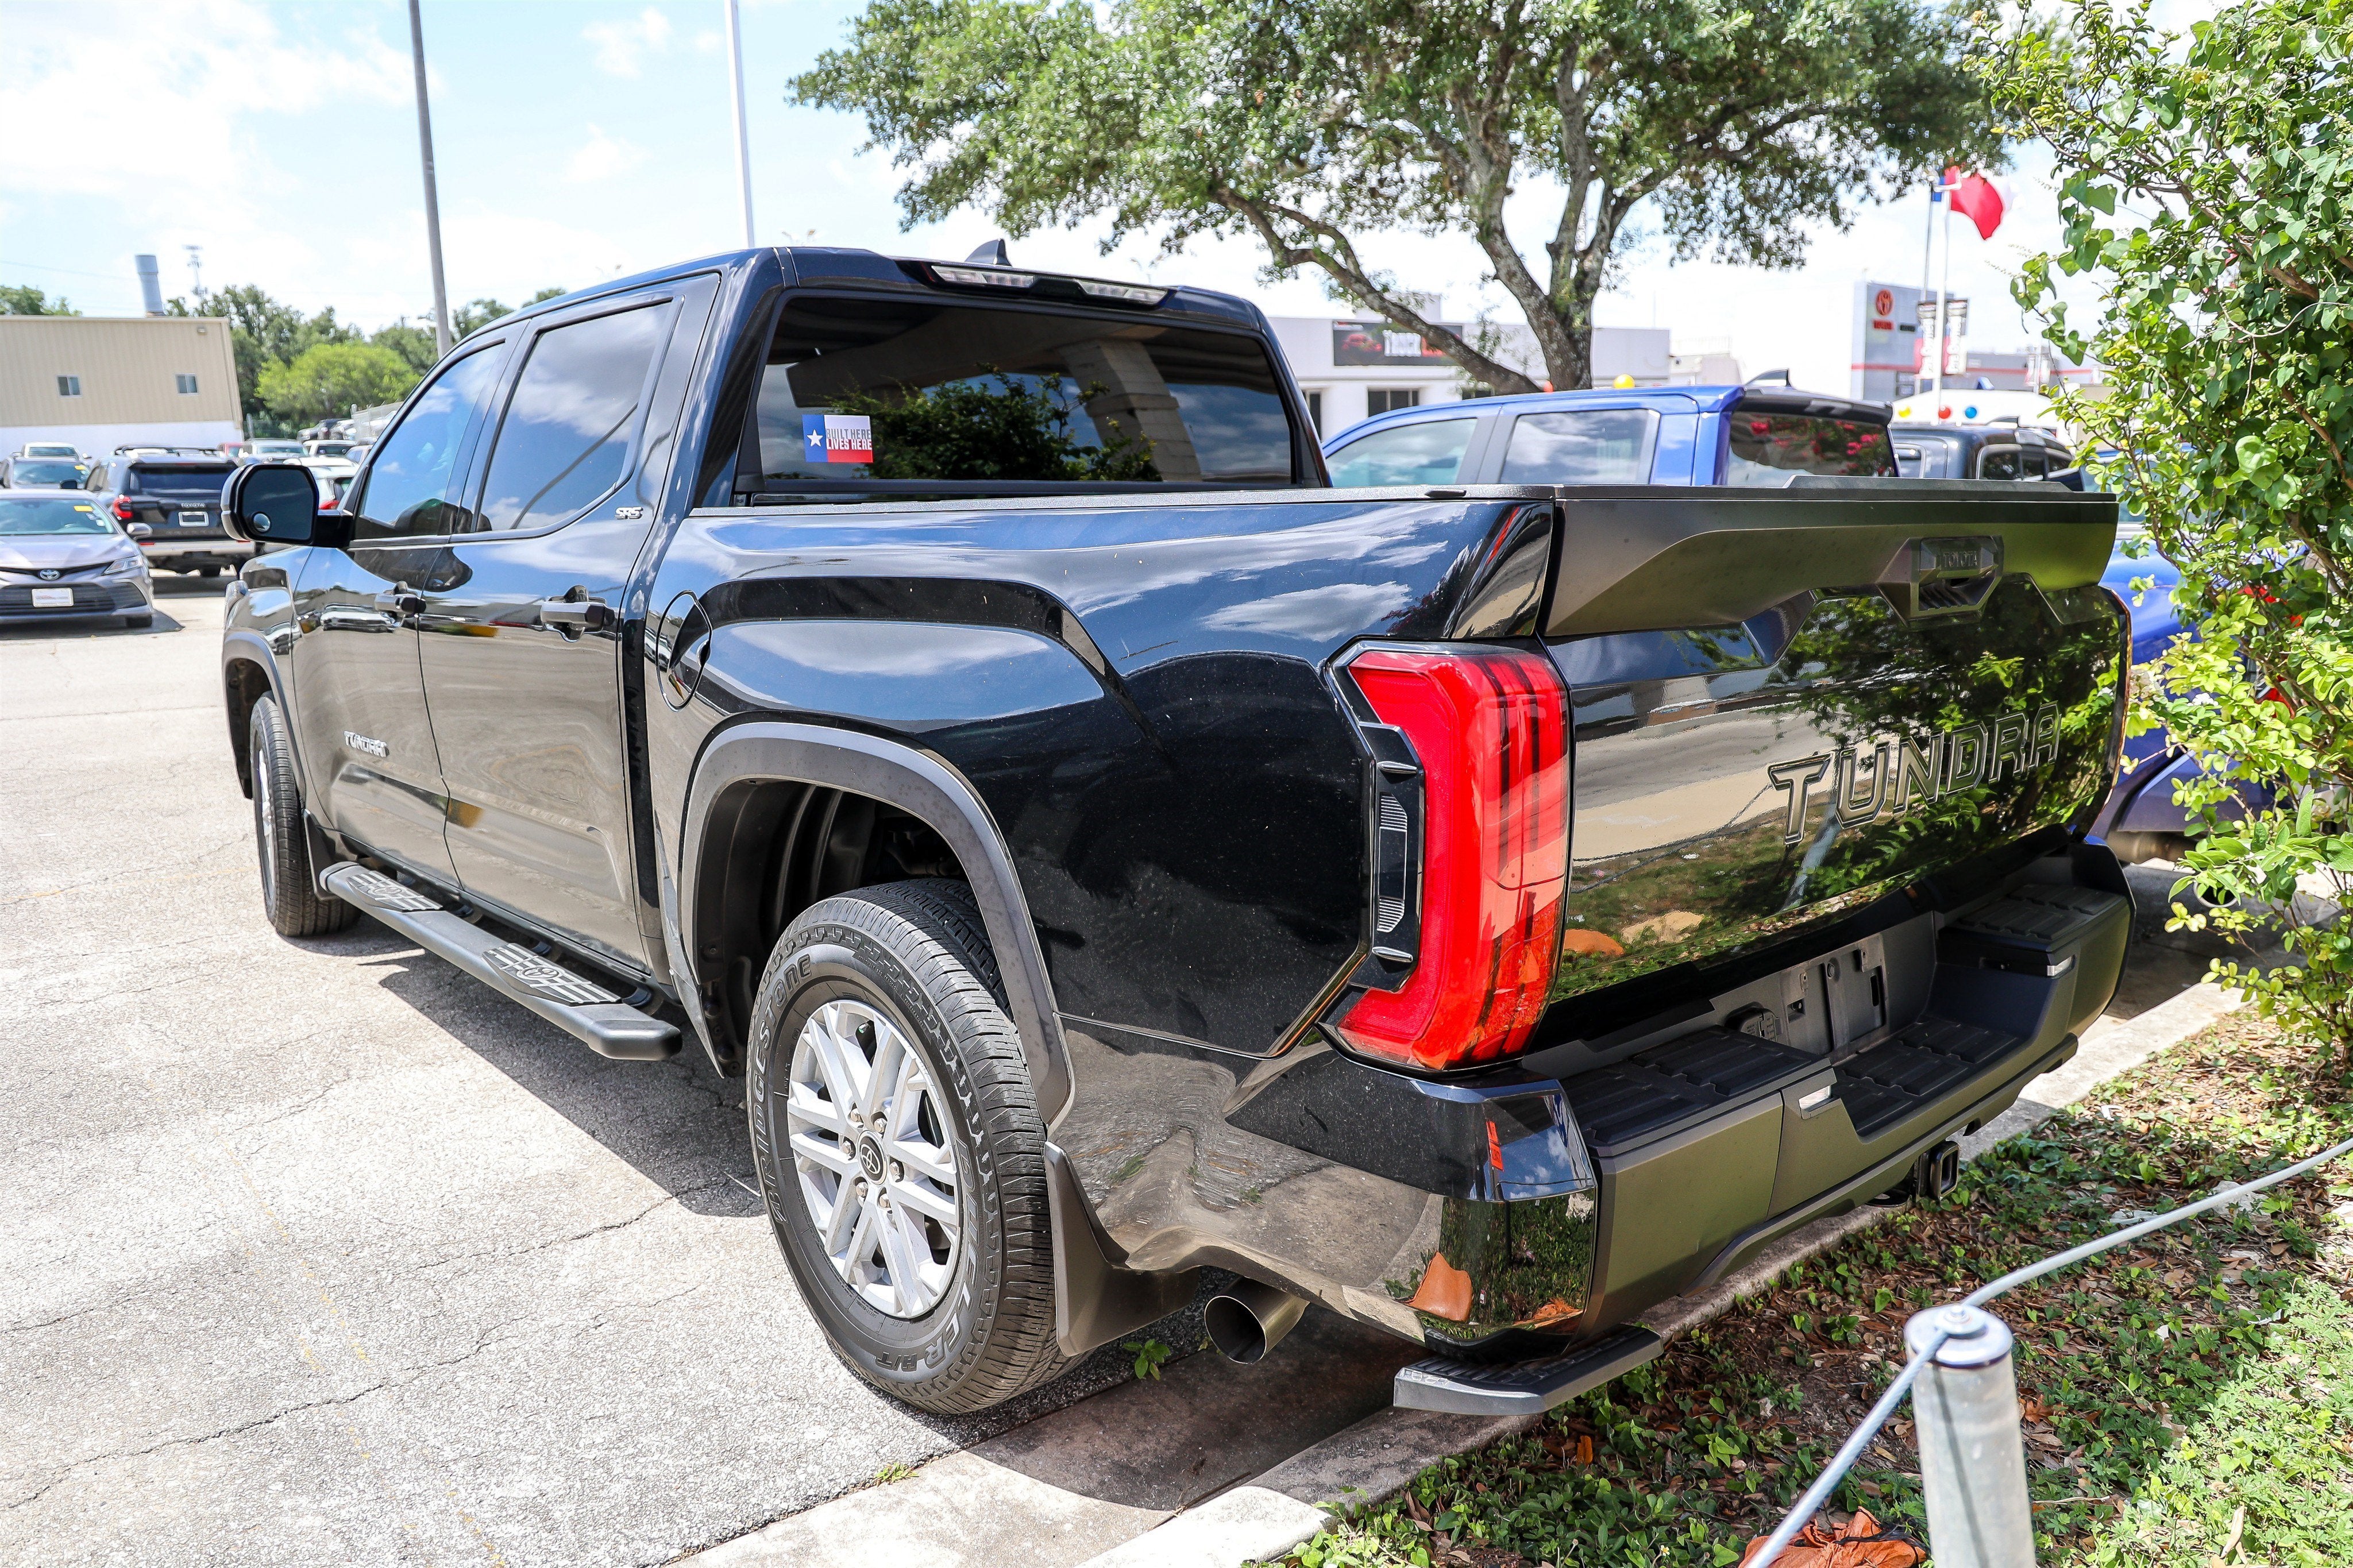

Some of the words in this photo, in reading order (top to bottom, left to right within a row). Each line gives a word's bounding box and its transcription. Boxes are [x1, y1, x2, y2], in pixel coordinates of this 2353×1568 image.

[826, 428, 849, 439] BUILT
[851, 428, 871, 440] HERE
[827, 439, 850, 450] LIVES
[851, 439, 872, 450] HERE
[614, 507, 643, 519] SR5
[1943, 551, 1978, 568] TOYOTA
[344, 731, 389, 758] TUNDRA
[1768, 701, 2062, 845] TUNDRA
[750, 953, 812, 1225] BRIDGESTONE
[924, 1134, 979, 1369] DUELER
[874, 1351, 917, 1372] H/T
